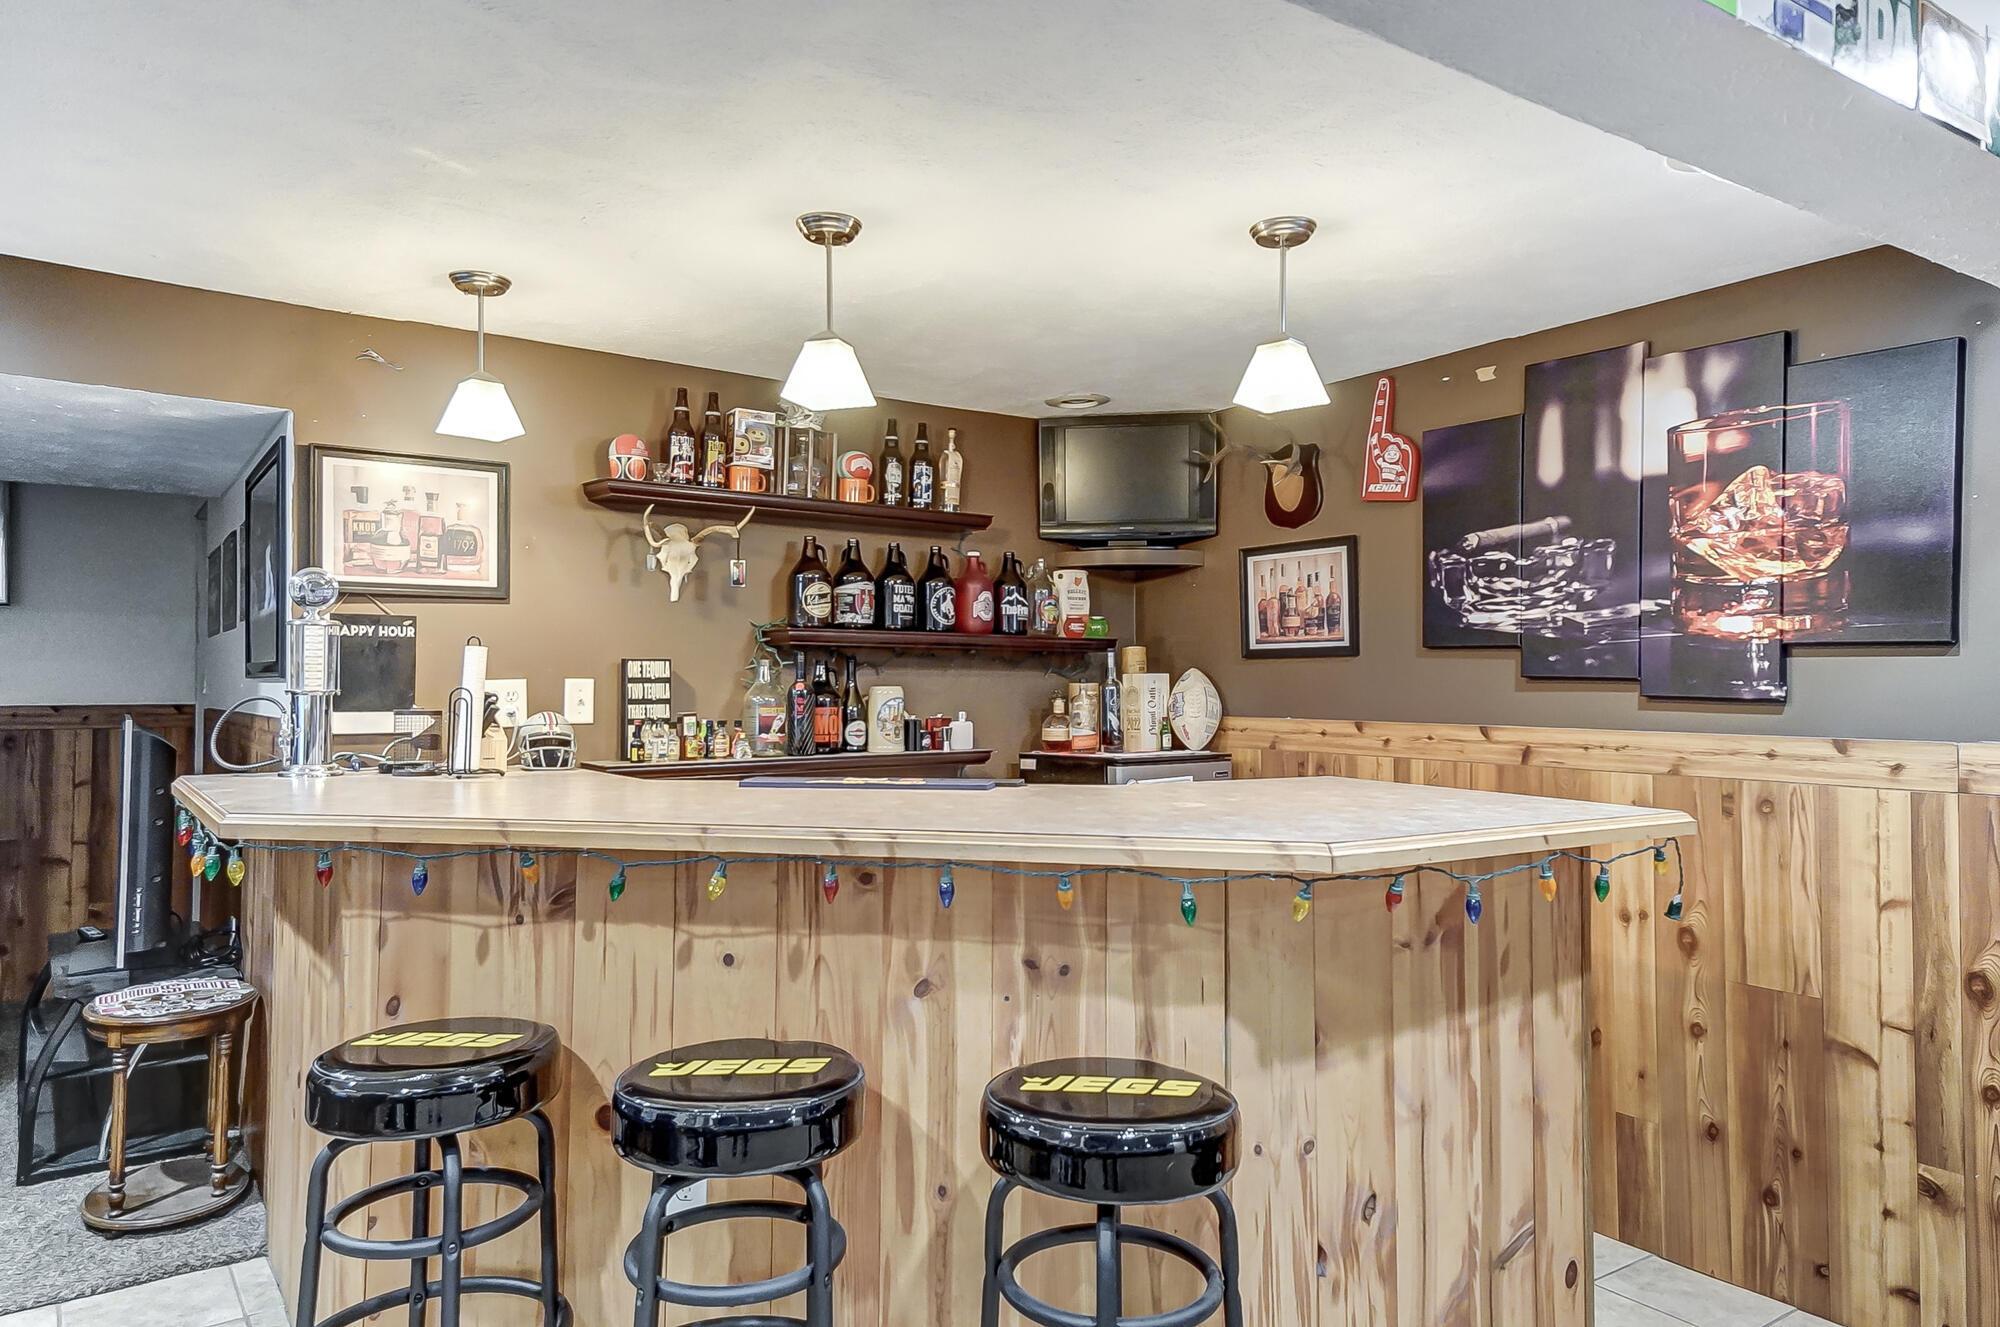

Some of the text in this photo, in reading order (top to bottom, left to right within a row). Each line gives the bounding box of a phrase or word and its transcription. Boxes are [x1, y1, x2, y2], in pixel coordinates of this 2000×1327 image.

[1368, 484, 1402, 493] KENDA
[352, 521, 376, 532] KNOB
[453, 539, 475, 552] 1792
[379, 625, 416, 638] HOUR
[628, 660, 671, 680] ONE TEQUILA
[628, 682, 671, 700] TWO TEQUILA
[1147, 687, 1157, 709] Oath
[628, 703, 671, 720] THREE TEQUILA
[350, 1032, 525, 1048] JEGS
[648, 1058, 832, 1077] JEGS
[1019, 1075, 1202, 1097] JEGS
